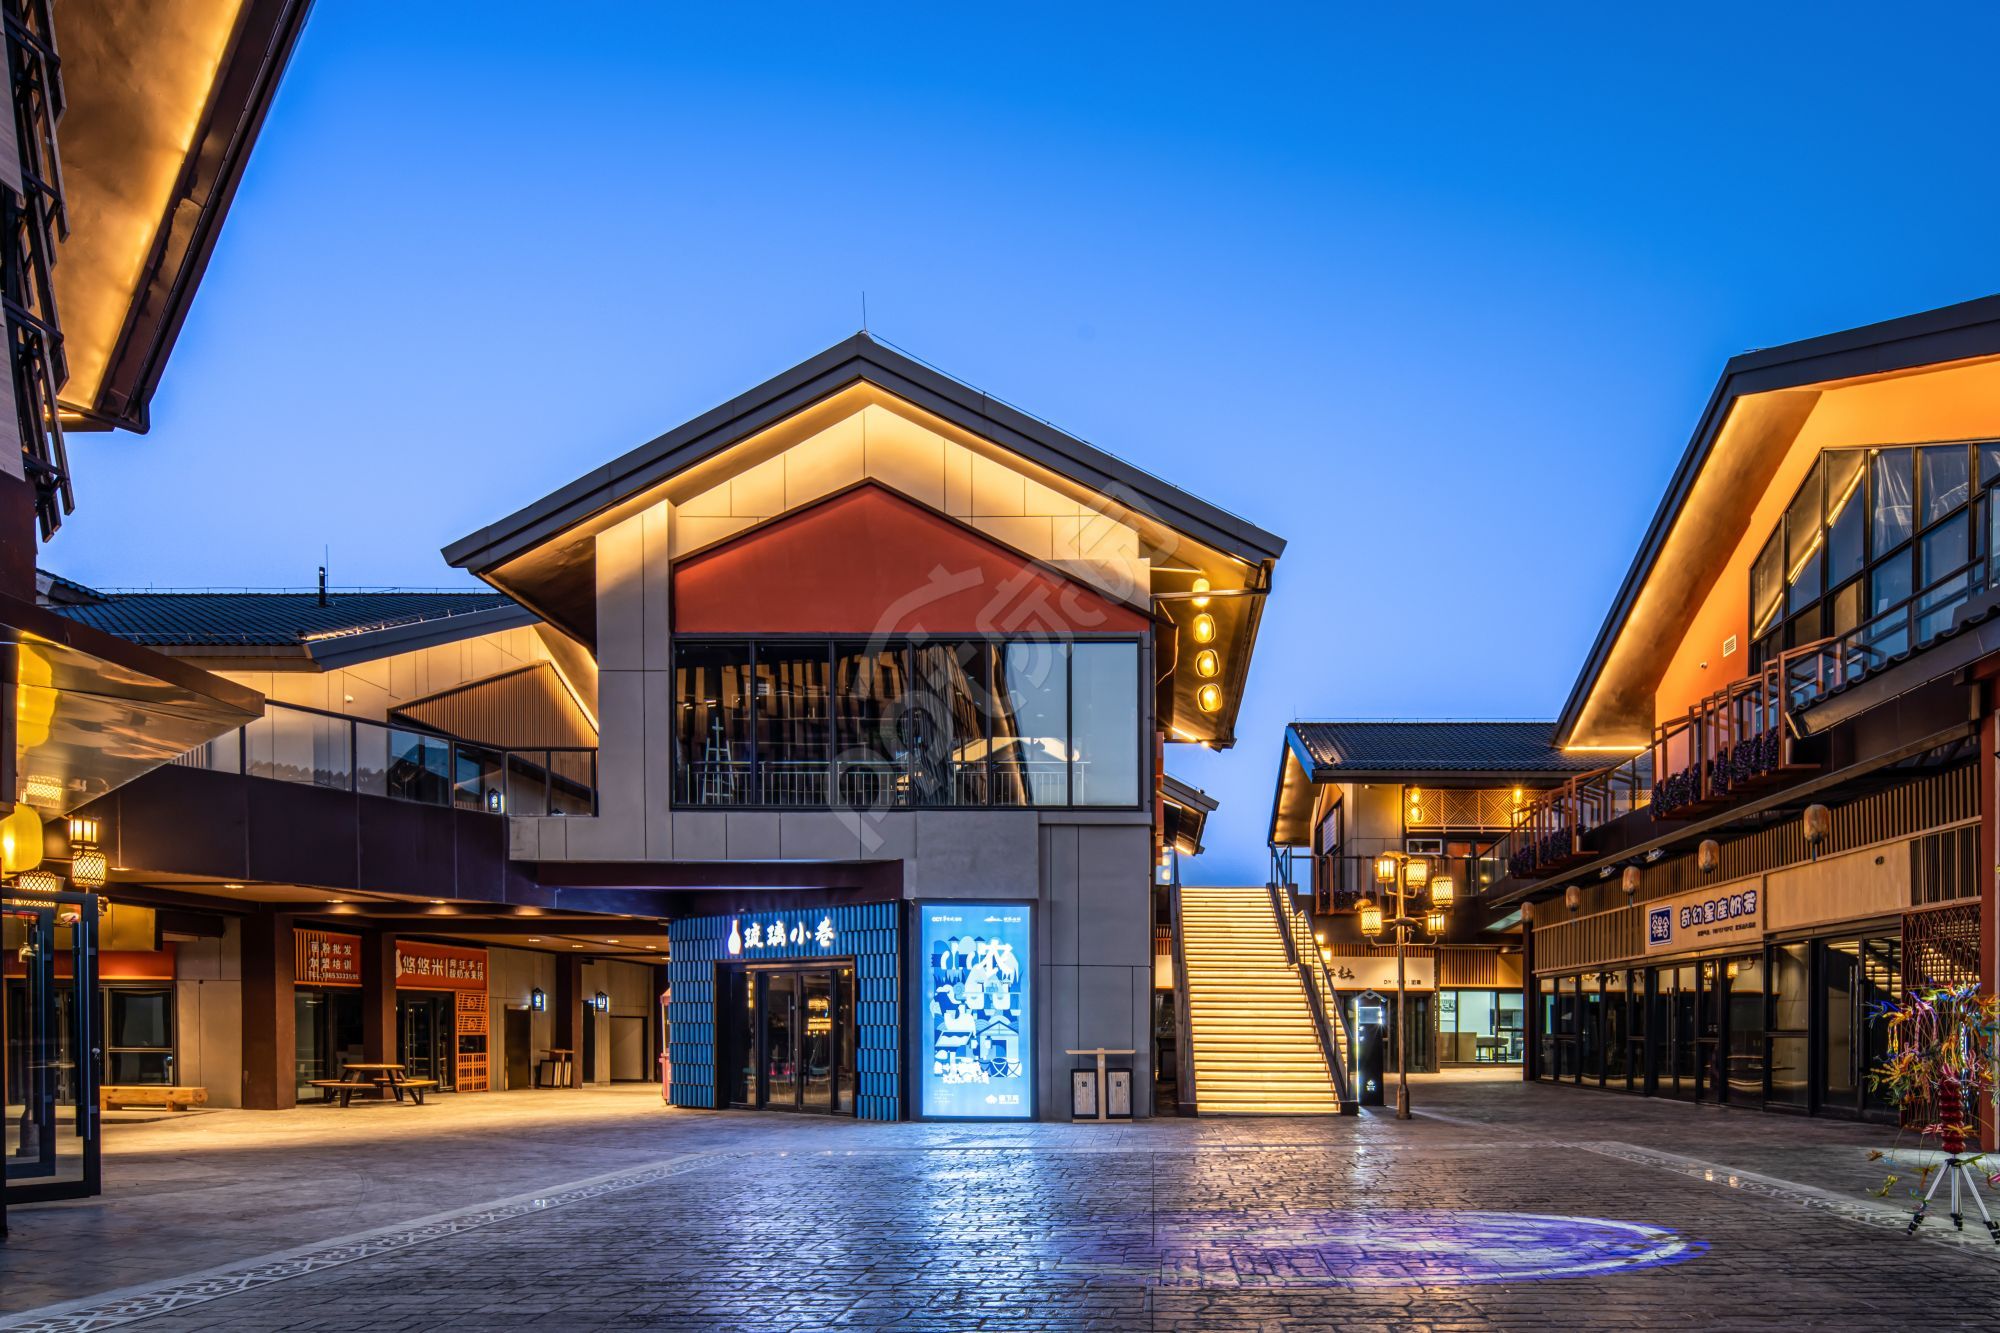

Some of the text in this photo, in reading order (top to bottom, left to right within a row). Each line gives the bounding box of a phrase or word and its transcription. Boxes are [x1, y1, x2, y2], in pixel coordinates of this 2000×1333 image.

[1680, 889, 1758, 929] 奇幻星座奶茶
[308, 956, 352, 971] 加盟培训
[402, 955, 444, 977] 悠悠米
[449, 958, 484, 971] 网红手打
